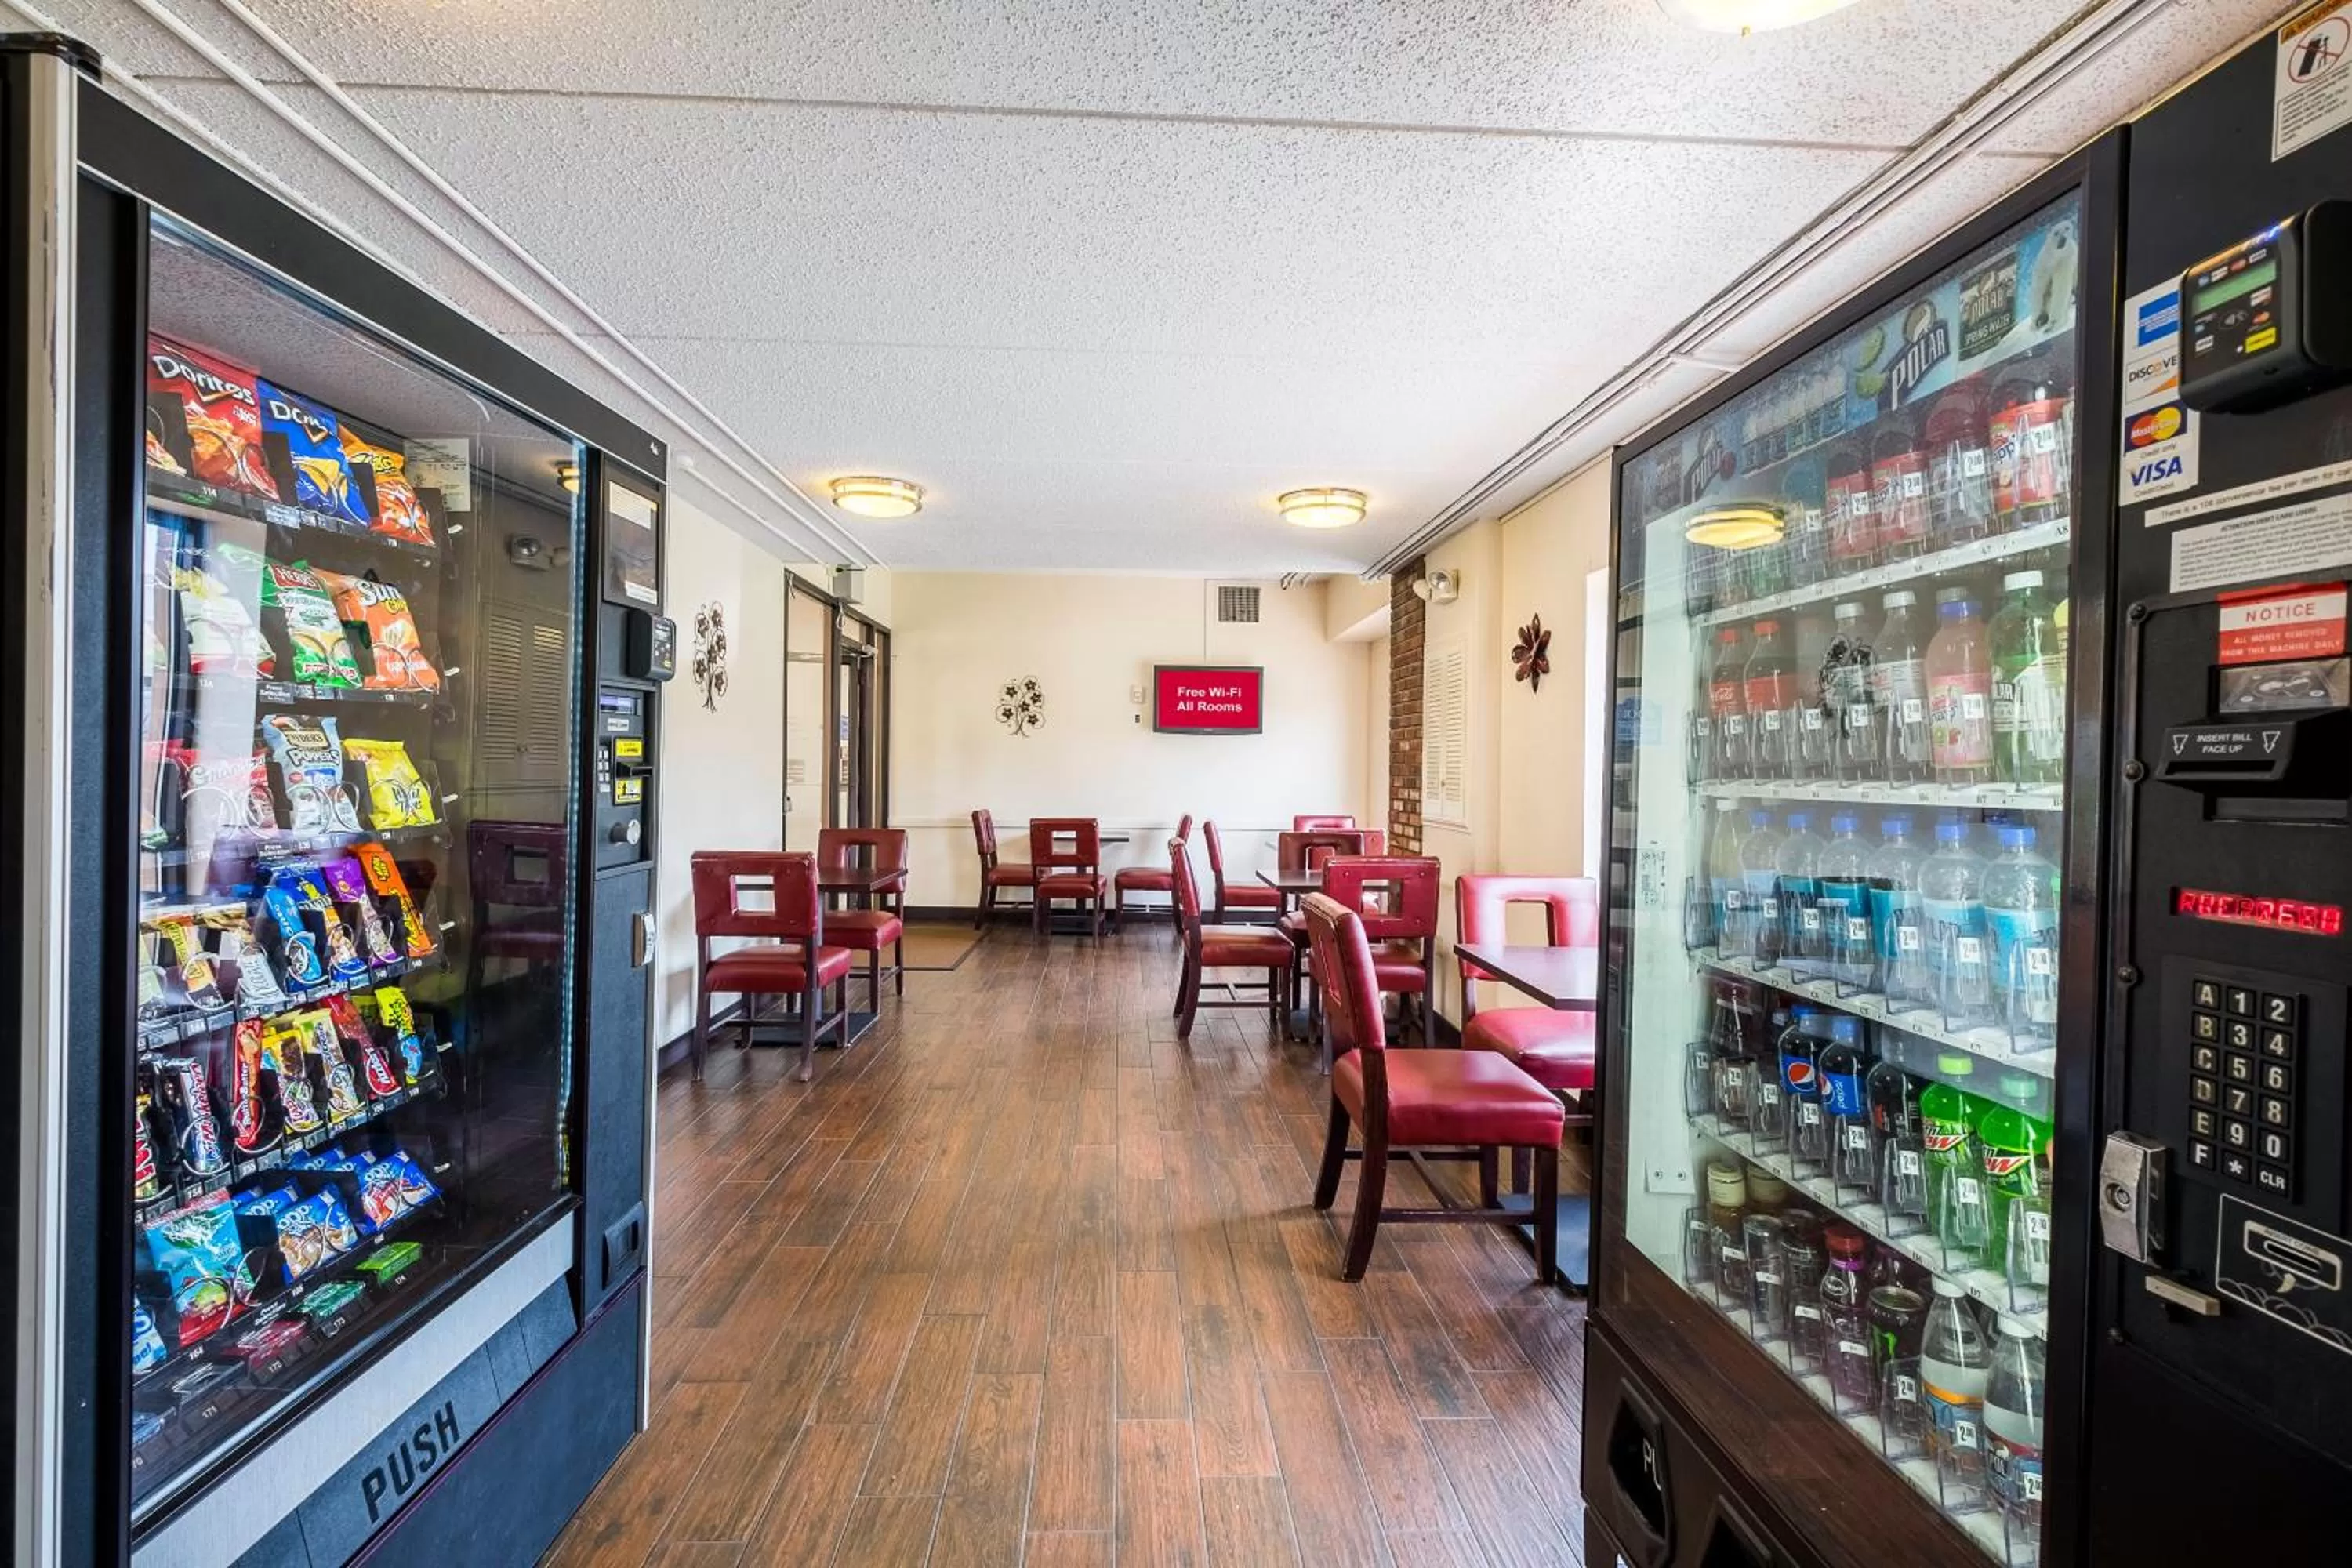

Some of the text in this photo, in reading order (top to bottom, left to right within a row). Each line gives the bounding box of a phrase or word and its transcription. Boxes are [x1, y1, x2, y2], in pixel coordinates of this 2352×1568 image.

[152, 355, 255, 405] Doritos
[1891, 328, 1946, 412] POLAR
[2129, 358, 2178, 383] DISCOVE
[2130, 456, 2183, 487] VISA
[355, 578, 402, 606] Sun
[2245, 602, 2316, 622] NOTICE
[2234, 634, 2247, 644] ALL
[2252, 631, 2281, 643] MONEY
[2270, 641, 2309, 652] MACHINE
[2314, 640, 2341, 651] DAILY
[1177, 687, 1241, 697] Free Wi-Fi
[1177, 702, 1243, 712] All Rooms
[2197, 732, 2252, 742] INSERT BILL
[2201, 744, 2243, 753] FACE UP
[2201, 985, 2285, 1022] A 1 2
[2198, 1016, 2284, 1055] B 3 4
[2198, 1048, 2282, 1089] C 5 6
[2197, 1079, 2281, 1123] D 7 8
[2196, 1112, 2281, 1157] E 9 0
[2195, 1144, 2208, 1166] F
[2259, 1170, 2285, 1190] CLR
[361, 1399, 460, 1524] PUSH
